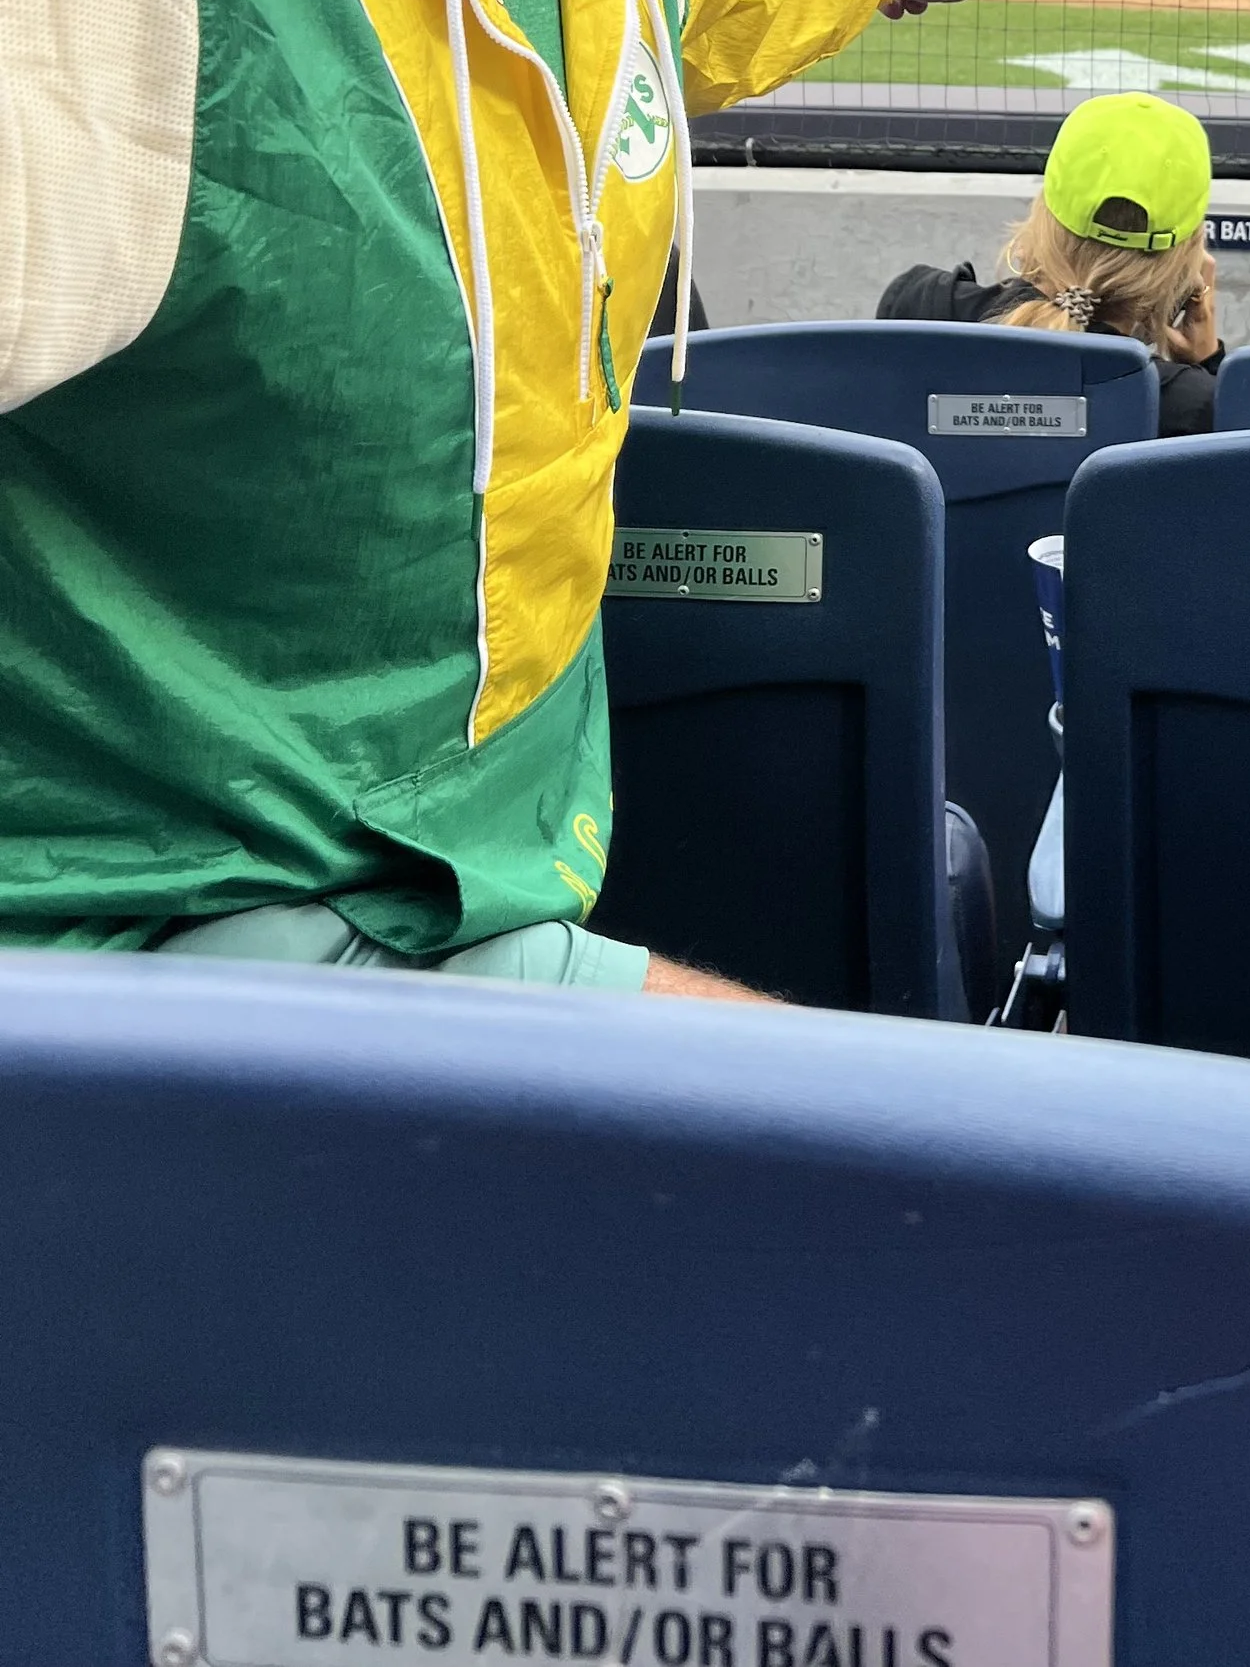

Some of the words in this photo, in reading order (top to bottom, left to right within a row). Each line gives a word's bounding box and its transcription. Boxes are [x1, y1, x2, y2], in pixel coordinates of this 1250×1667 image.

[971, 402, 985, 414] BE
[988, 403, 1020, 414] ALERT
[1023, 403, 1044, 414] FOR
[953, 415, 980, 426] BATS
[982, 416, 1026, 427] AND/OR
[1029, 416, 1062, 427] BALLS
[623, 542, 646, 560] BE
[651, 543, 707, 562] ALERT
[713, 545, 747, 563] FOR
[642, 565, 717, 585] AND/OR
[722, 567, 778, 586] BALLS
[403, 1515, 482, 1581] BE
[503, 1523, 702, 1593] ALERT
[721, 1537, 841, 1606] FOR
[295, 1582, 454, 1650] BATS
[473, 1598, 737, 1667] AND/OR
